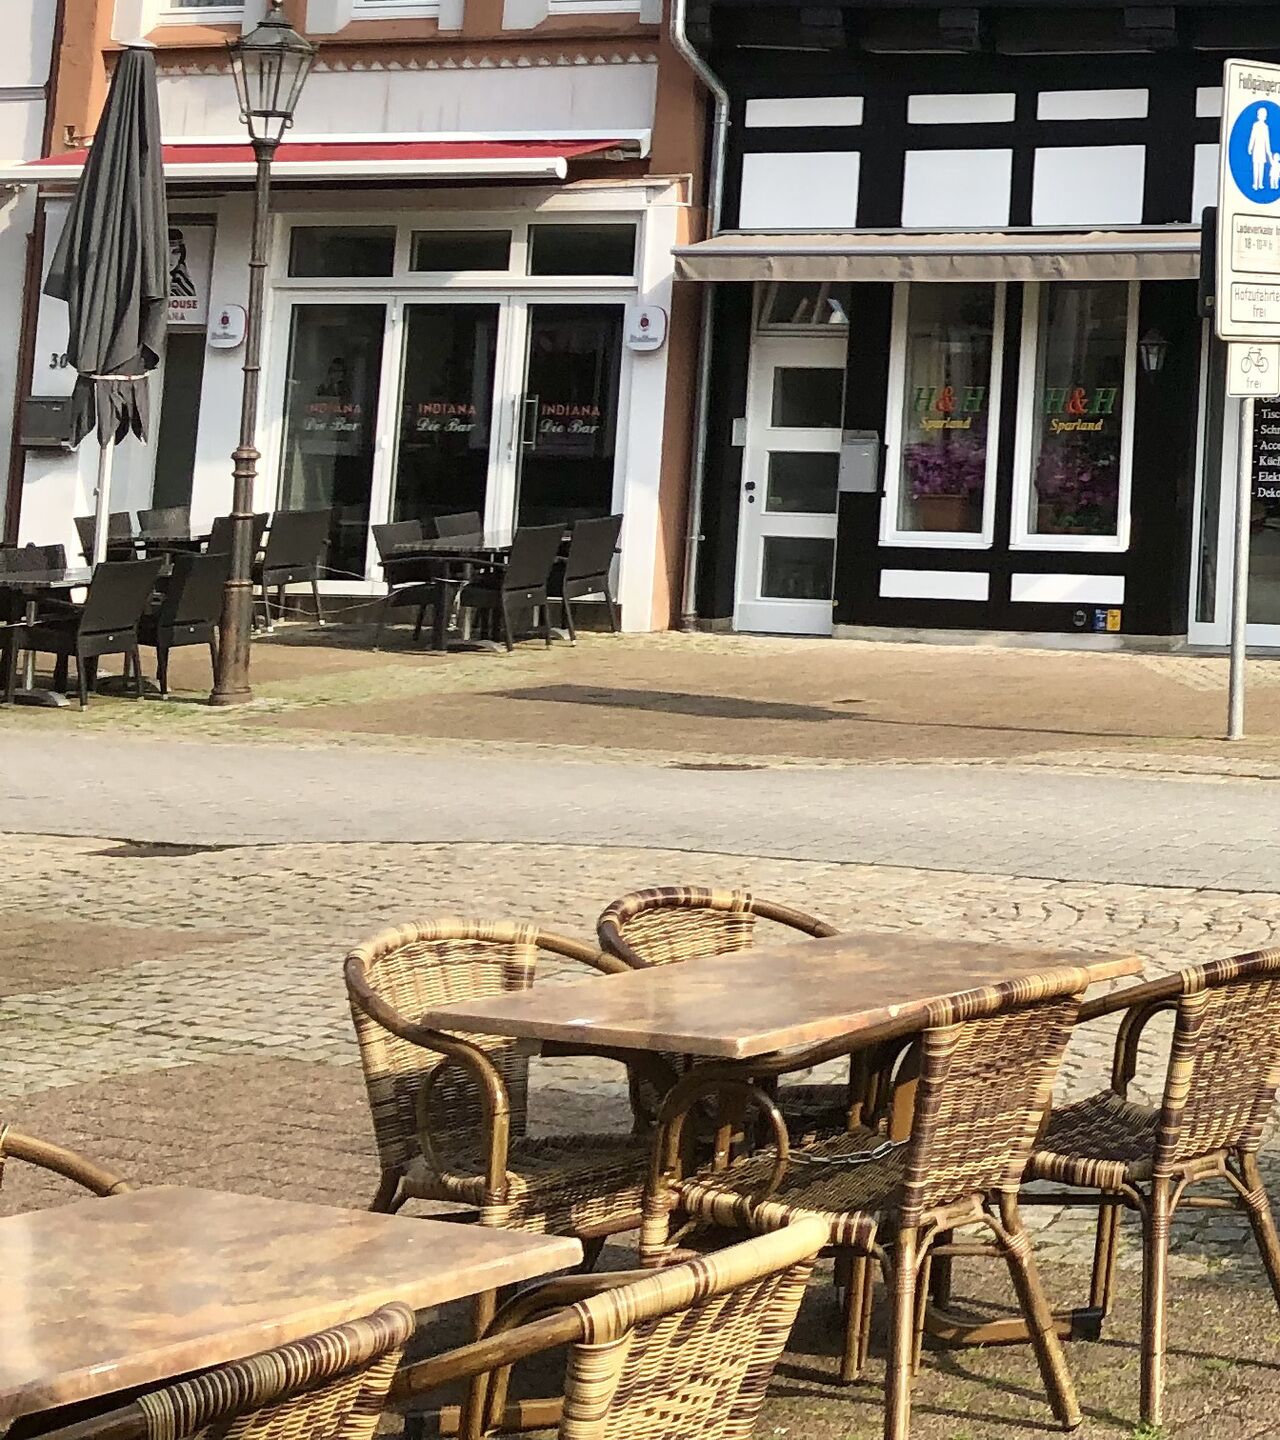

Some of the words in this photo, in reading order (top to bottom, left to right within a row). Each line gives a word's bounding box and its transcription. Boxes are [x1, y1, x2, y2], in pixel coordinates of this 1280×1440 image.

[1252, 304, 1267, 318] frei
[48, 352, 69, 370] 30
[1246, 376, 1263, 390] frei
[418, 403, 478, 416] INDIANA
[541, 404, 600, 417] INDIANA
[415, 417, 438, 432] Die
[444, 417, 477, 432] Bar
[540, 418, 565, 434] Die
[567, 419, 600, 434] Bar
[919, 417, 973, 432] Sparland
[1050, 418, 1104, 435] Sparland
